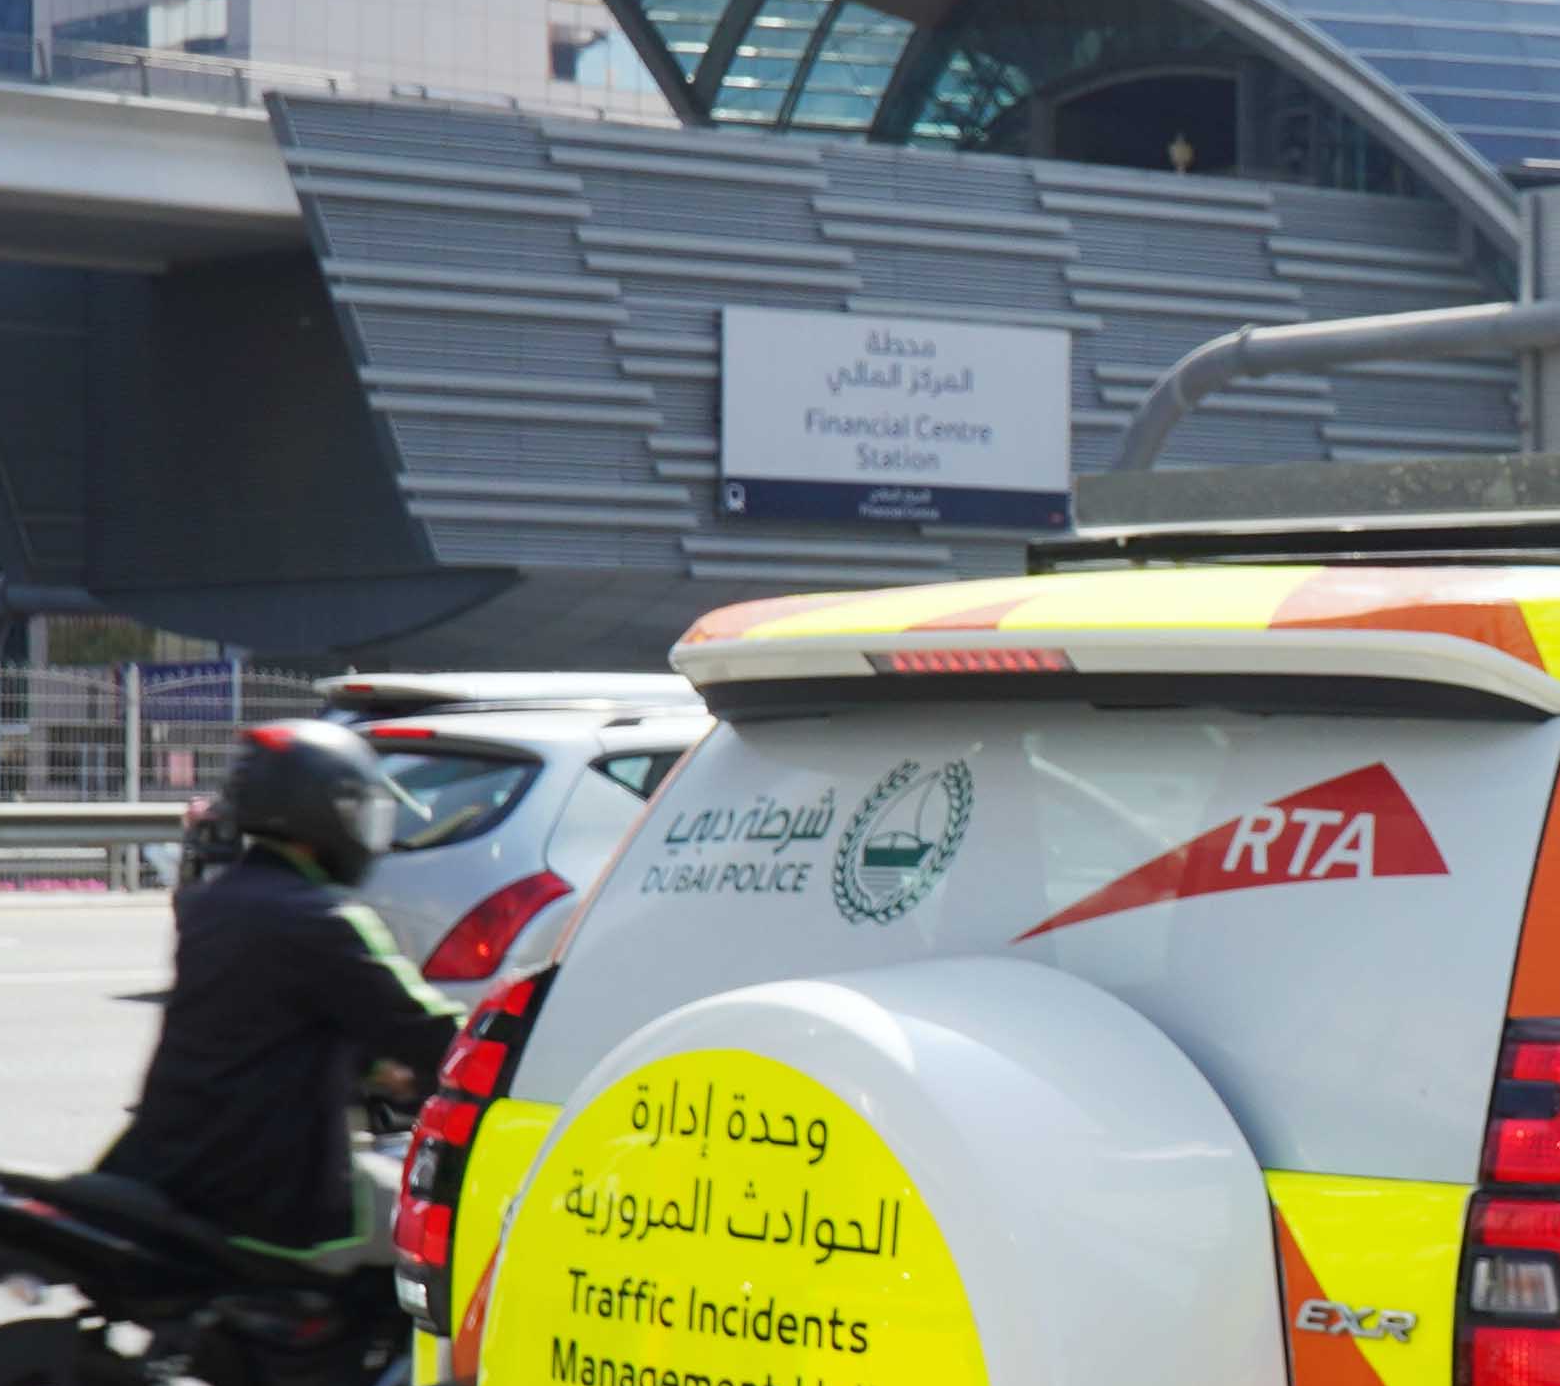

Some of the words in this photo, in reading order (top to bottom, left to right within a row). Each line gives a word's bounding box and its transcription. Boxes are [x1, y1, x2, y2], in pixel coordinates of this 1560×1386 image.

[864, 330, 937, 359] محطة
[826, 360, 902, 396] المالي
[906, 366, 974, 398] المركز
[804, 408, 910, 436] Financial
[914, 412, 993, 445] Centre
[856, 444, 941, 471] Station
[664, 807, 736, 857] دبي
[734, 786, 836, 854] شرطة
[1221, 805, 1377, 878] RTA
[641, 864, 716, 894] DUBAI
[716, 862, 813, 893] POLICE
[631, 1080, 715, 1158] إدارة
[726, 1092, 828, 1165] وحدة
[564, 1168, 712, 1241] المرورية
[727, 1181, 901, 1264] الحوادث
[568, 1268, 675, 1329] Traffic
[688, 1286, 869, 1354] Incidents
[1295, 1298, 1418, 1343] EXR
